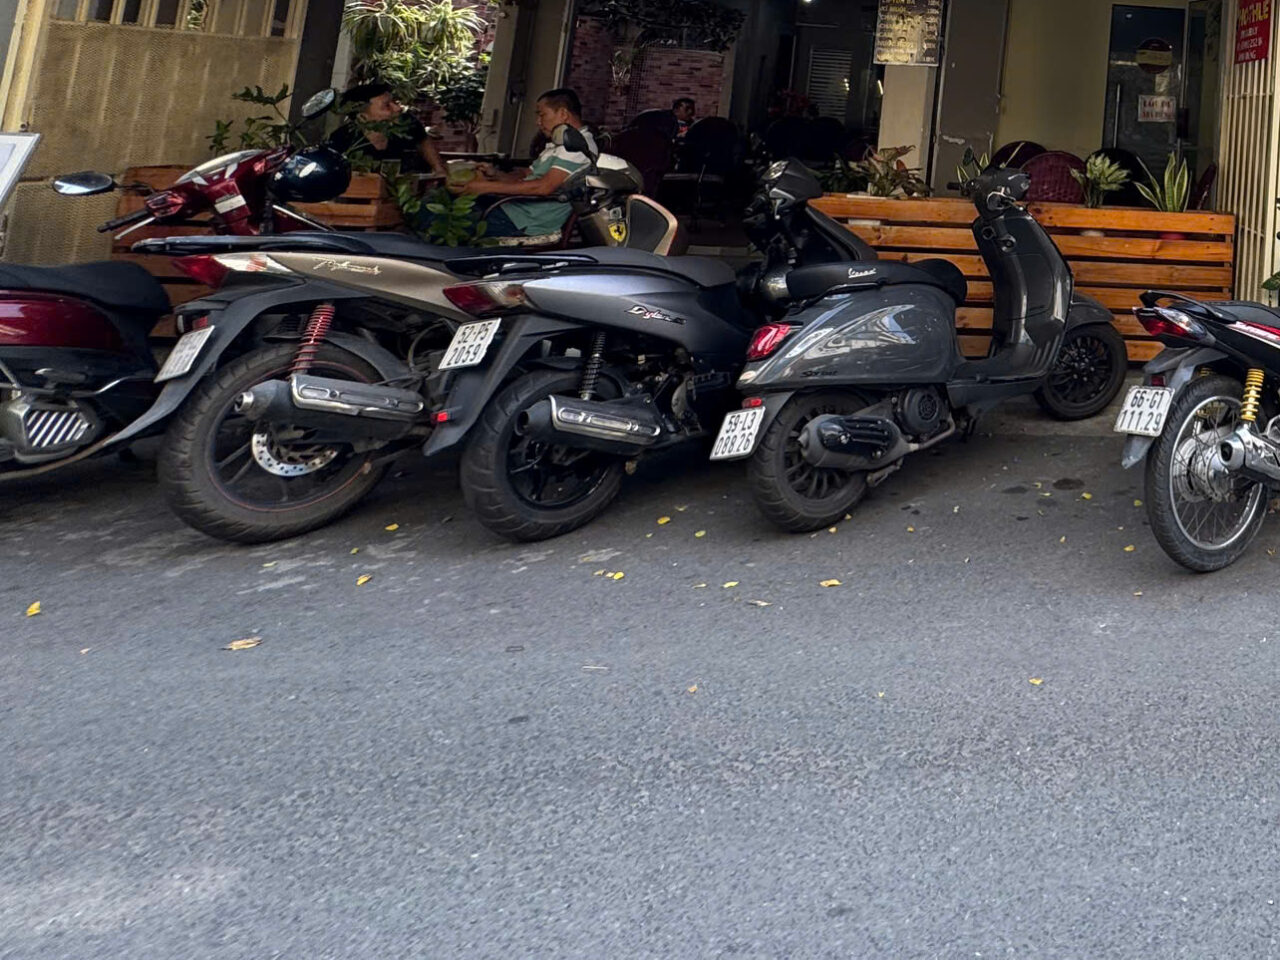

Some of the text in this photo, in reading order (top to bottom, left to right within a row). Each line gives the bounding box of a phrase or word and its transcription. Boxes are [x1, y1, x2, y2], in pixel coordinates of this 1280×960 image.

[457, 321, 493, 344] 52-P5
[446, 343, 481, 366] 2059
[1130, 390, 1165, 409] 66-G1
[725, 411, 757, 433] 59-L3
[1119, 409, 1162, 432] 111.29
